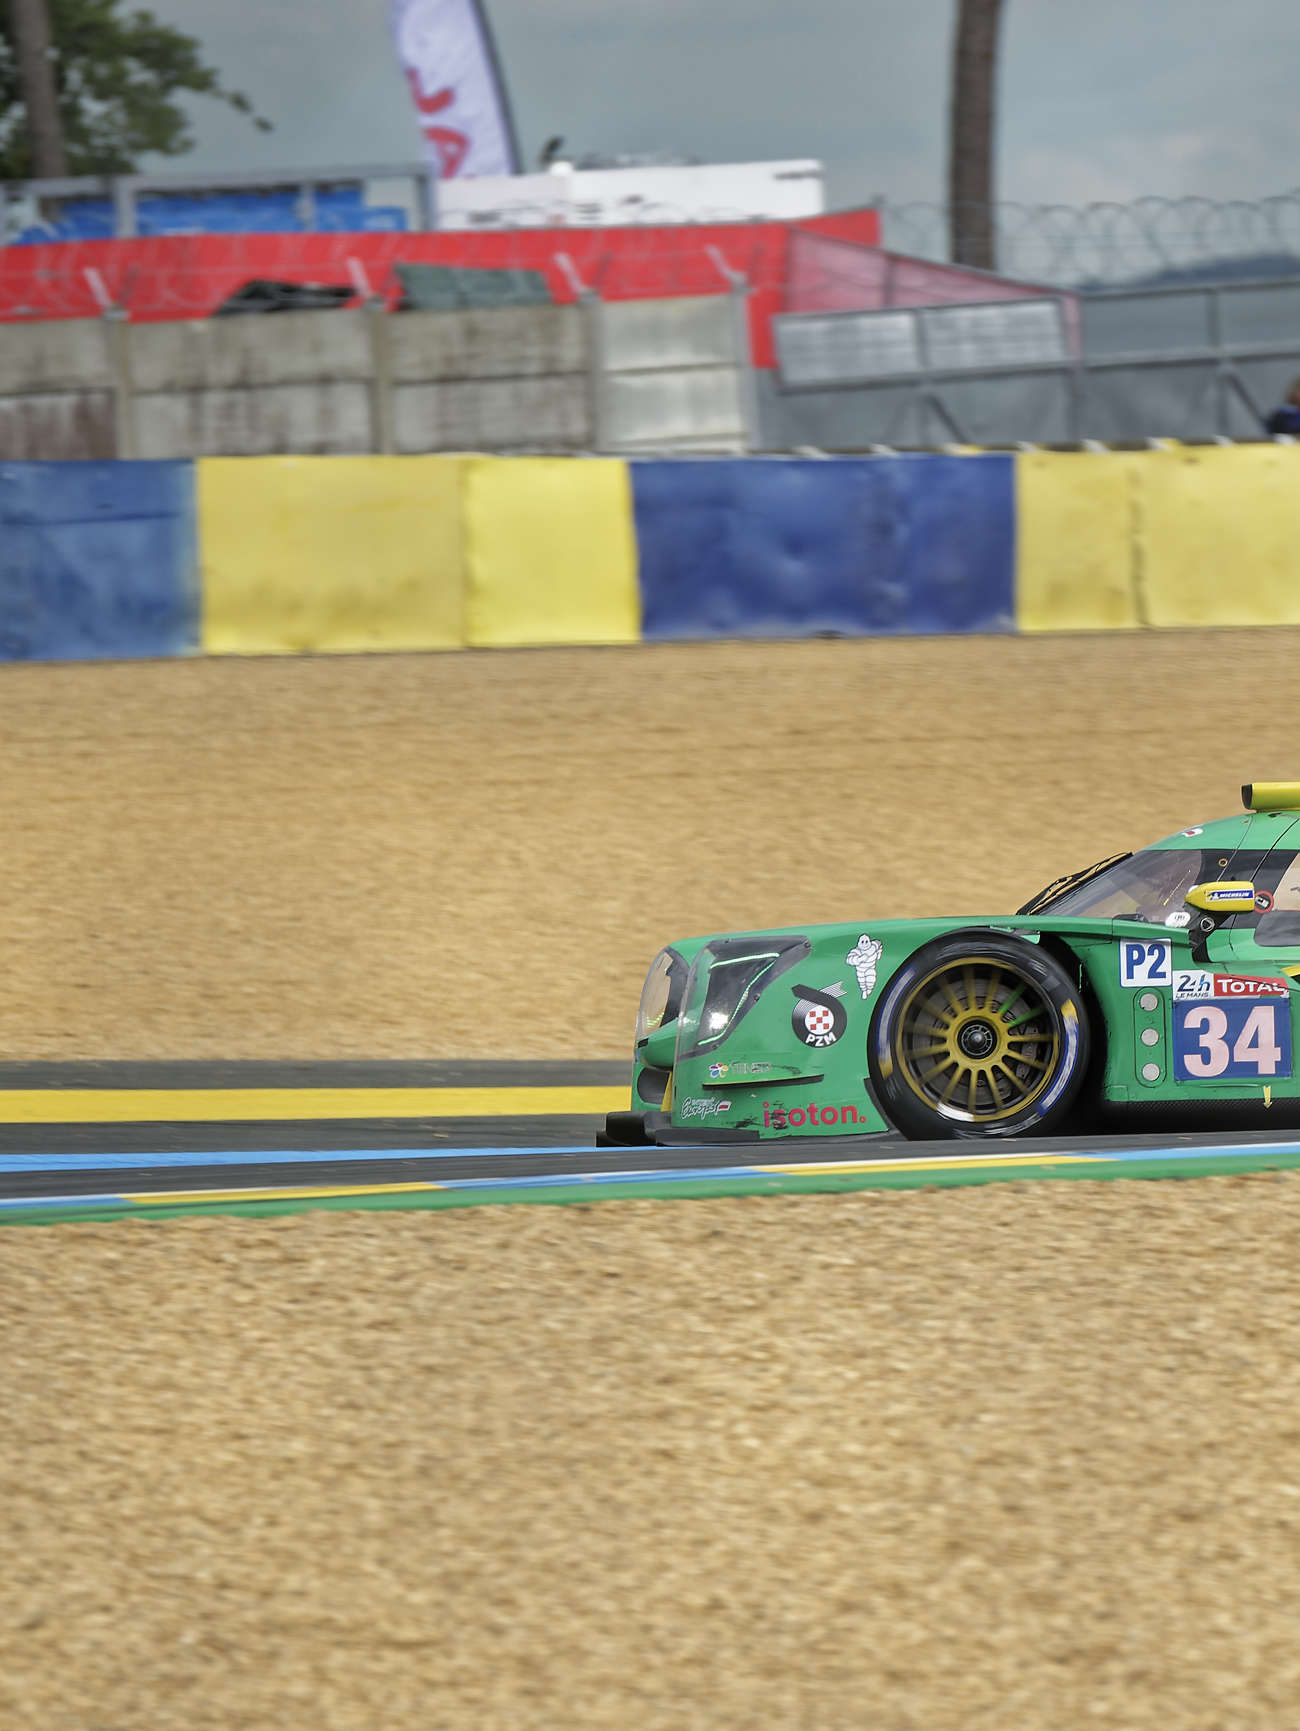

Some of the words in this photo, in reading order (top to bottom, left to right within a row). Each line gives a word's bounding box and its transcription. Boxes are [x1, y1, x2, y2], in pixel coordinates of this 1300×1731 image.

[1125, 943, 1167, 980] P2
[1177, 974, 1211, 993] 24h
[805, 1033, 837, 1046] PZM
[1183, 1005, 1282, 1078] 34
